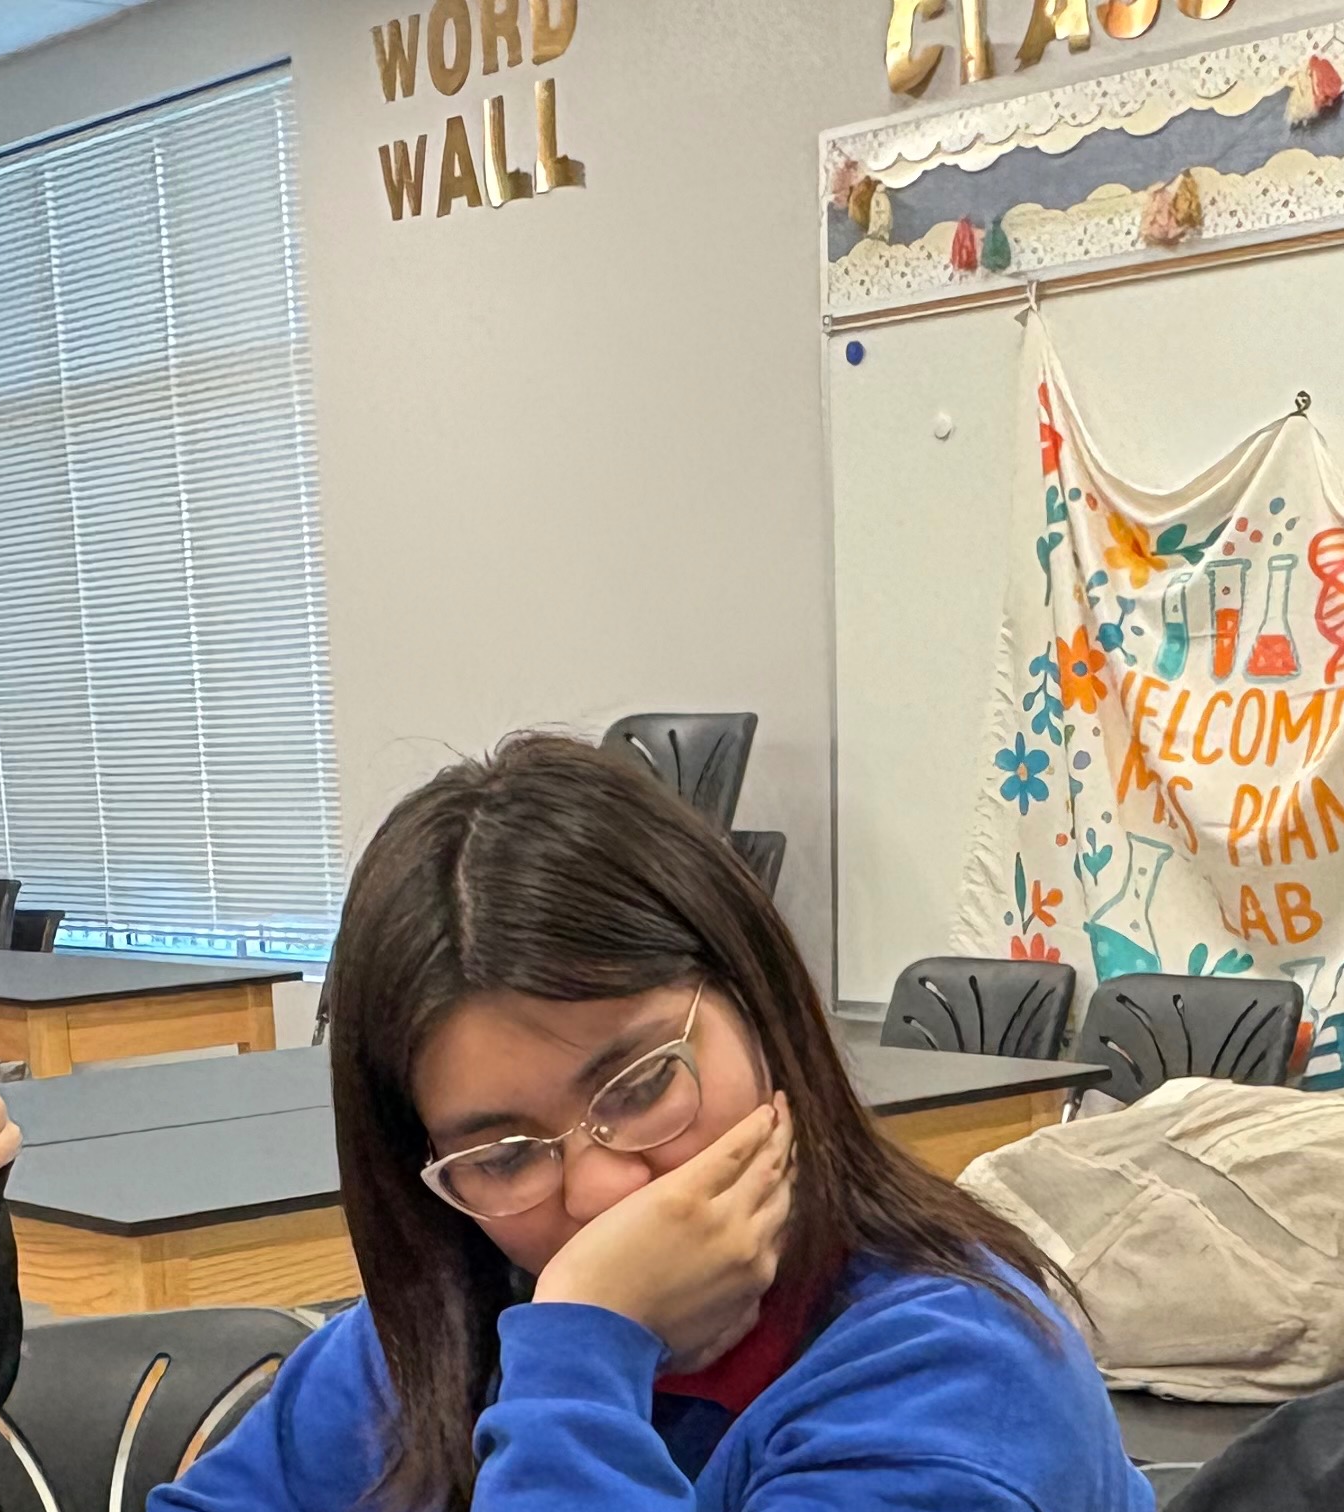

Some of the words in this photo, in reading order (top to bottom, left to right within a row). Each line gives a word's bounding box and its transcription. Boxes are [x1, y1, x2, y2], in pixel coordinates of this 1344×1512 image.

[369, 0, 578, 104] WORD
[377, 77, 587, 222] WALL
[1209, 881, 1323, 947] AB
